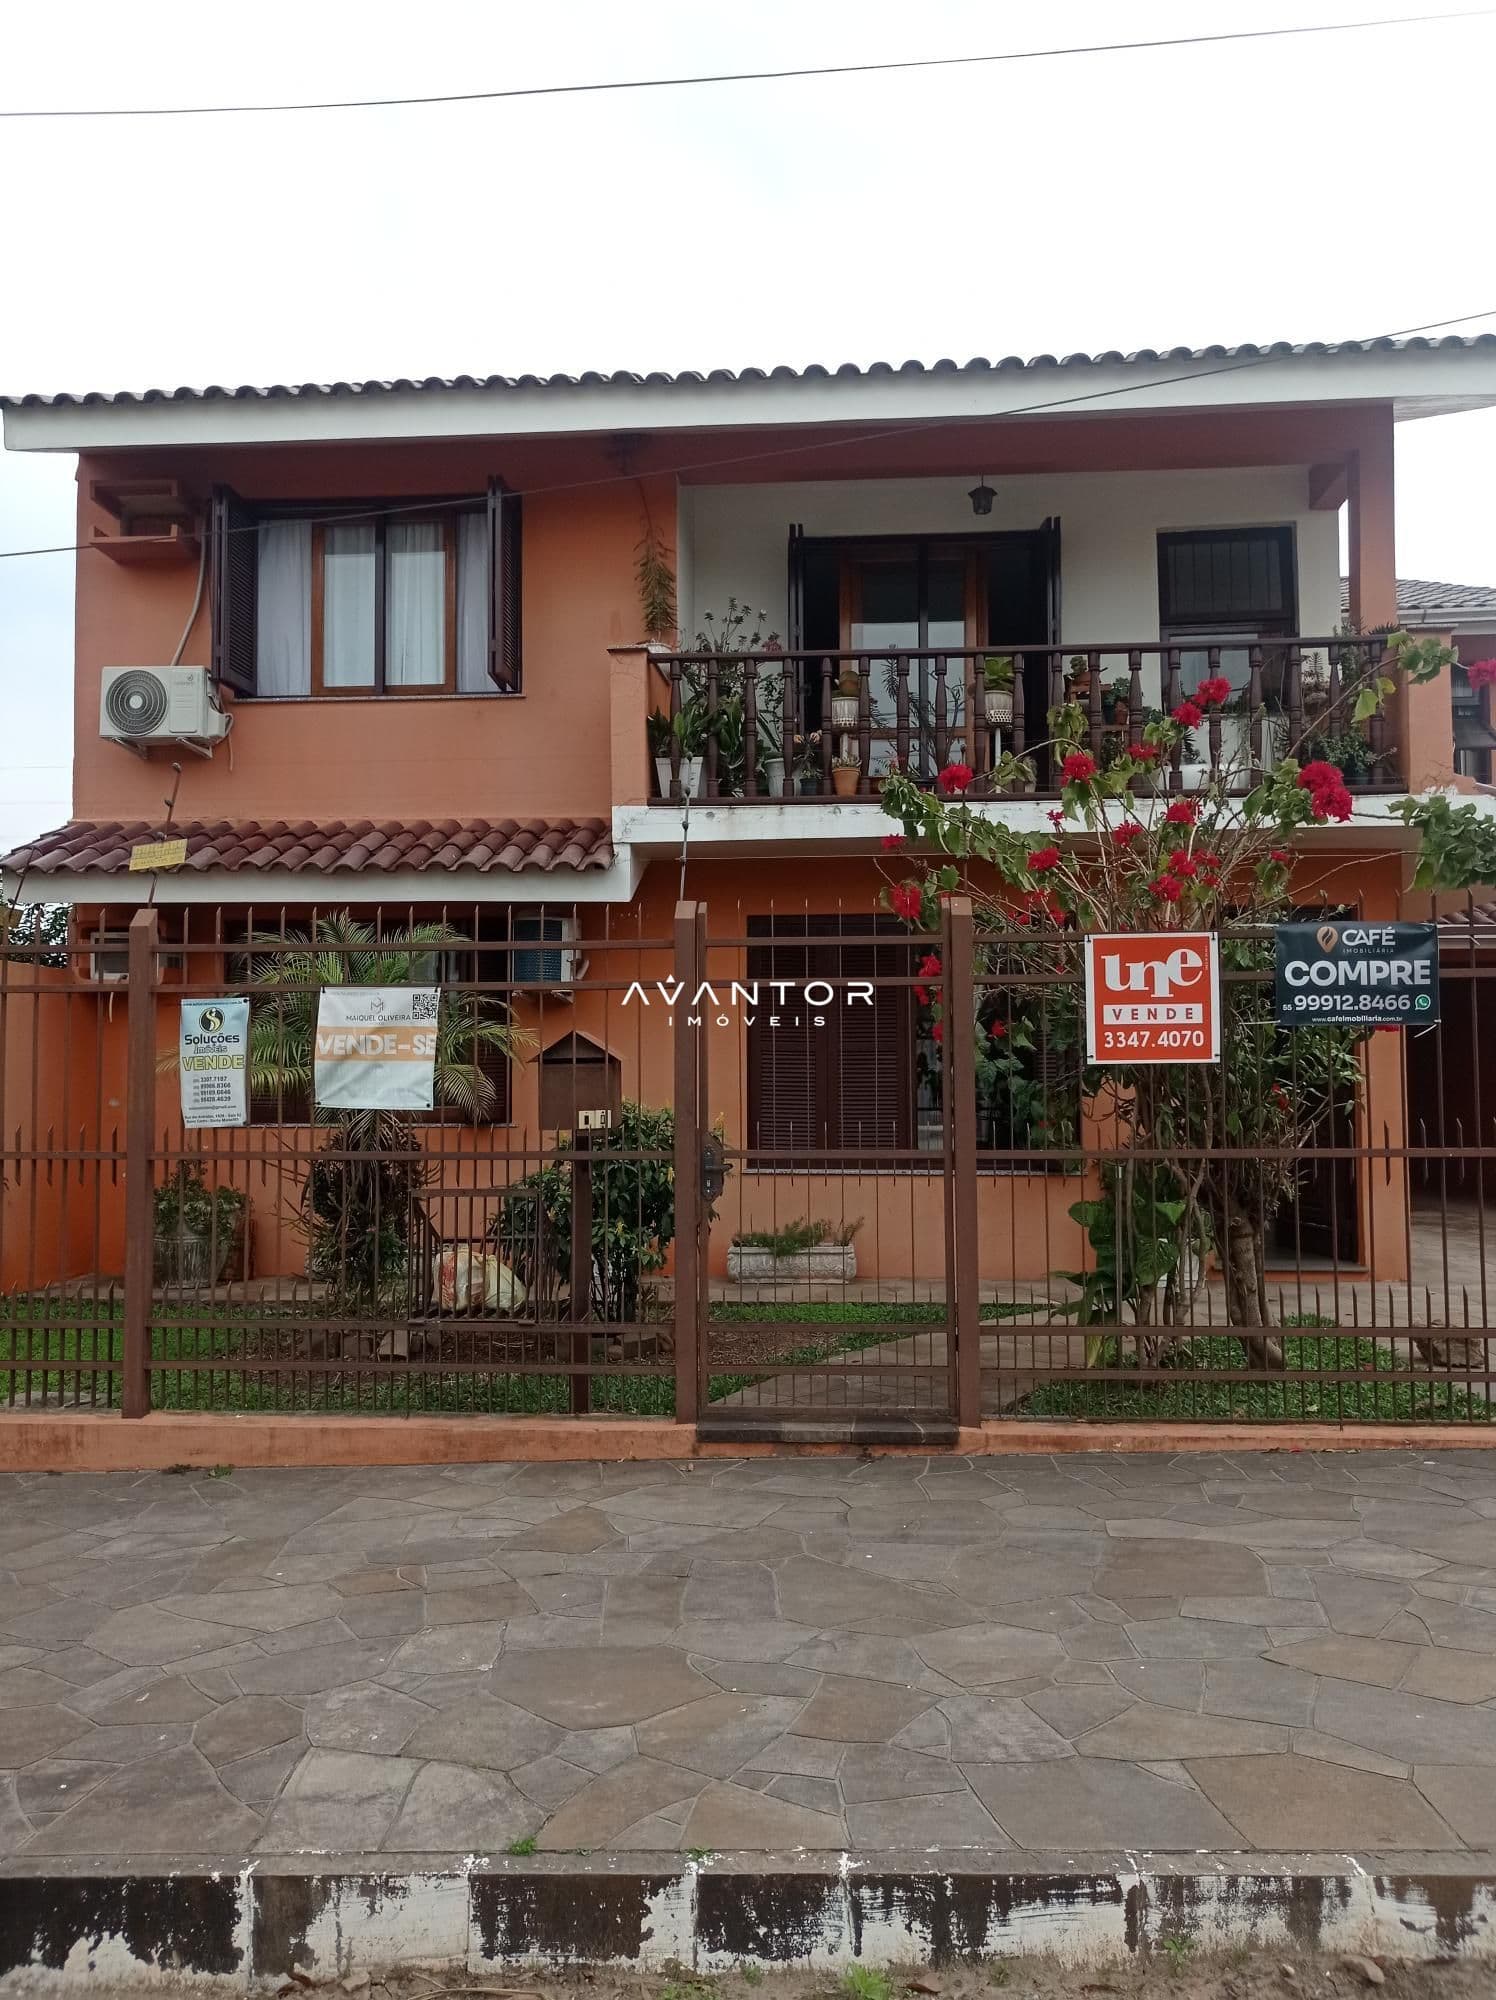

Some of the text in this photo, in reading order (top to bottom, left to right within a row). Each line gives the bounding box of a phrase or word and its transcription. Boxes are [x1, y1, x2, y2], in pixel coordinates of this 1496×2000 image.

[1341, 926, 1396, 946] CAFÉ
[1284, 960, 1431, 987] COMPRE
[1294, 994, 1411, 1011] 99912.8466
[345, 1014, 412, 1022] MAIQUEL OLIVEIRA
[1111, 1007, 1194, 1021] VENDE
[184, 1032, 240, 1046] Soluções
[316, 1033, 438, 1056] VENDE-SE
[1103, 1030, 1205, 1048] 3347.4070
[181, 1055, 245, 1071] VENDE
